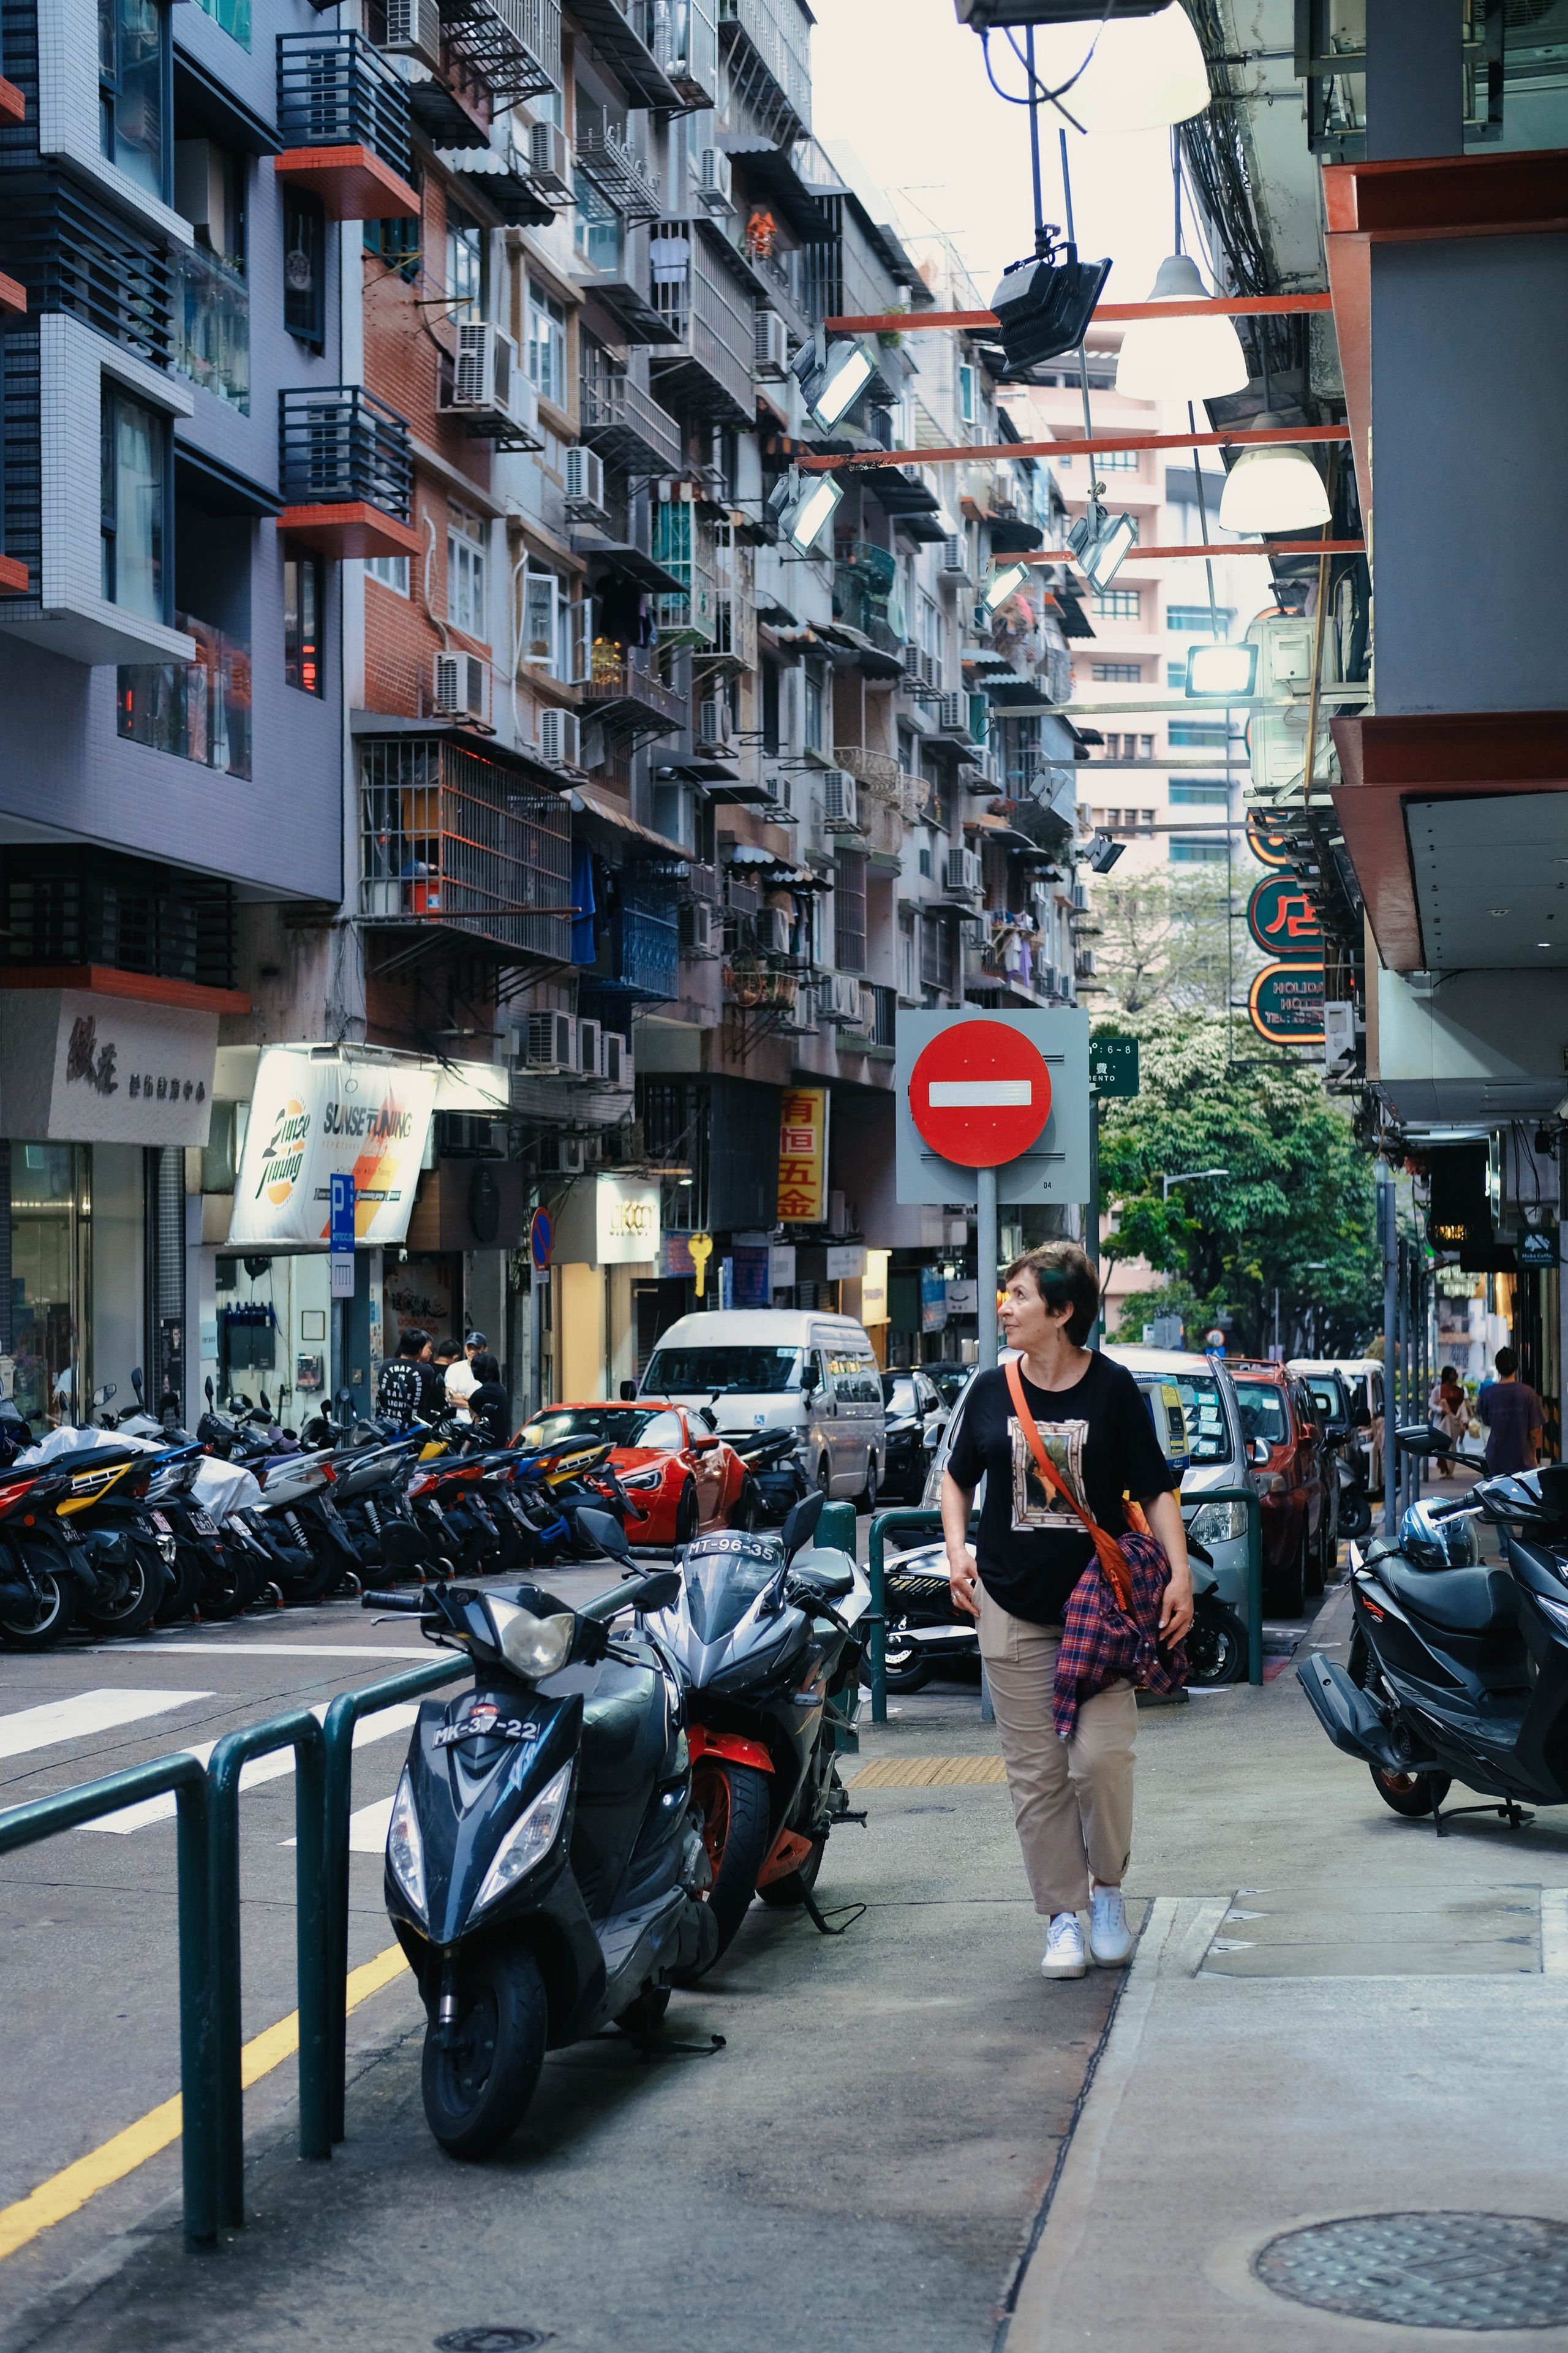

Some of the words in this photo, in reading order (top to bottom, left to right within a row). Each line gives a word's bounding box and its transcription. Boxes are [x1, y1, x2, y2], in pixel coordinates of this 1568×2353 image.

[333, 1179, 344, 1230] P
[688, 1538, 775, 1561] MT-96-35
[435, 1716, 538, 1745] MK-37-22
